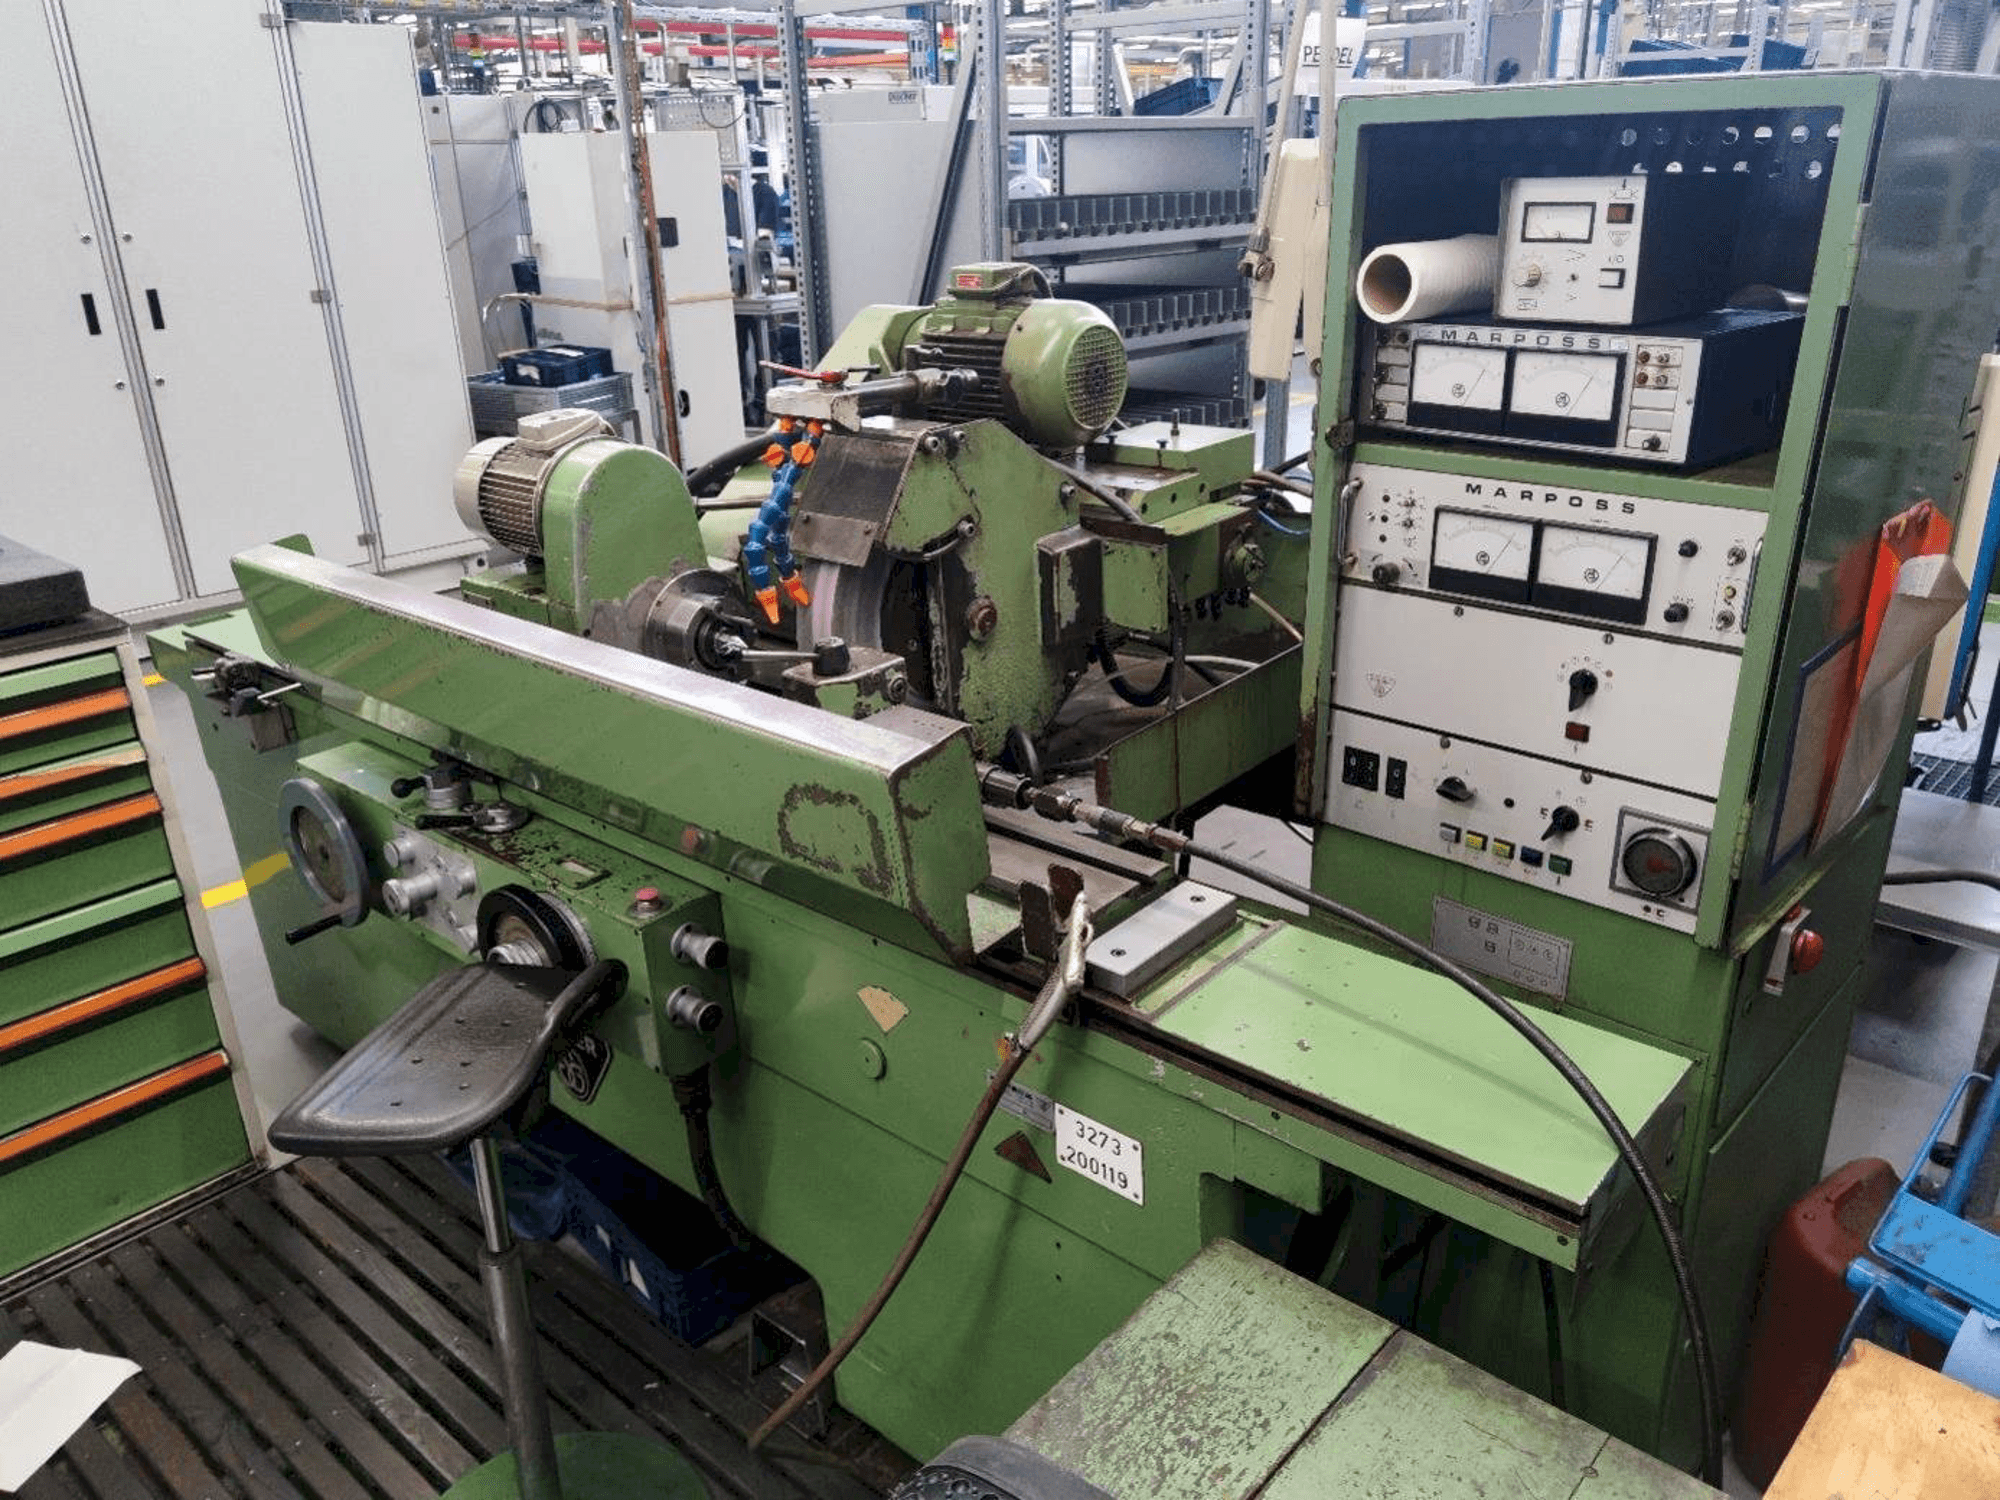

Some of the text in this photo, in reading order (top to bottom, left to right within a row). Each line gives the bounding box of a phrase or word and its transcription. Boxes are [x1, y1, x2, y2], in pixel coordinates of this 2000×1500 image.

[1441, 329, 1601, 349] MARPOSS
[1465, 483, 1635, 514] MARPOSS
[1075, 1120, 1121, 1156] 3273
[1066, 1145, 1128, 1189] 200119
